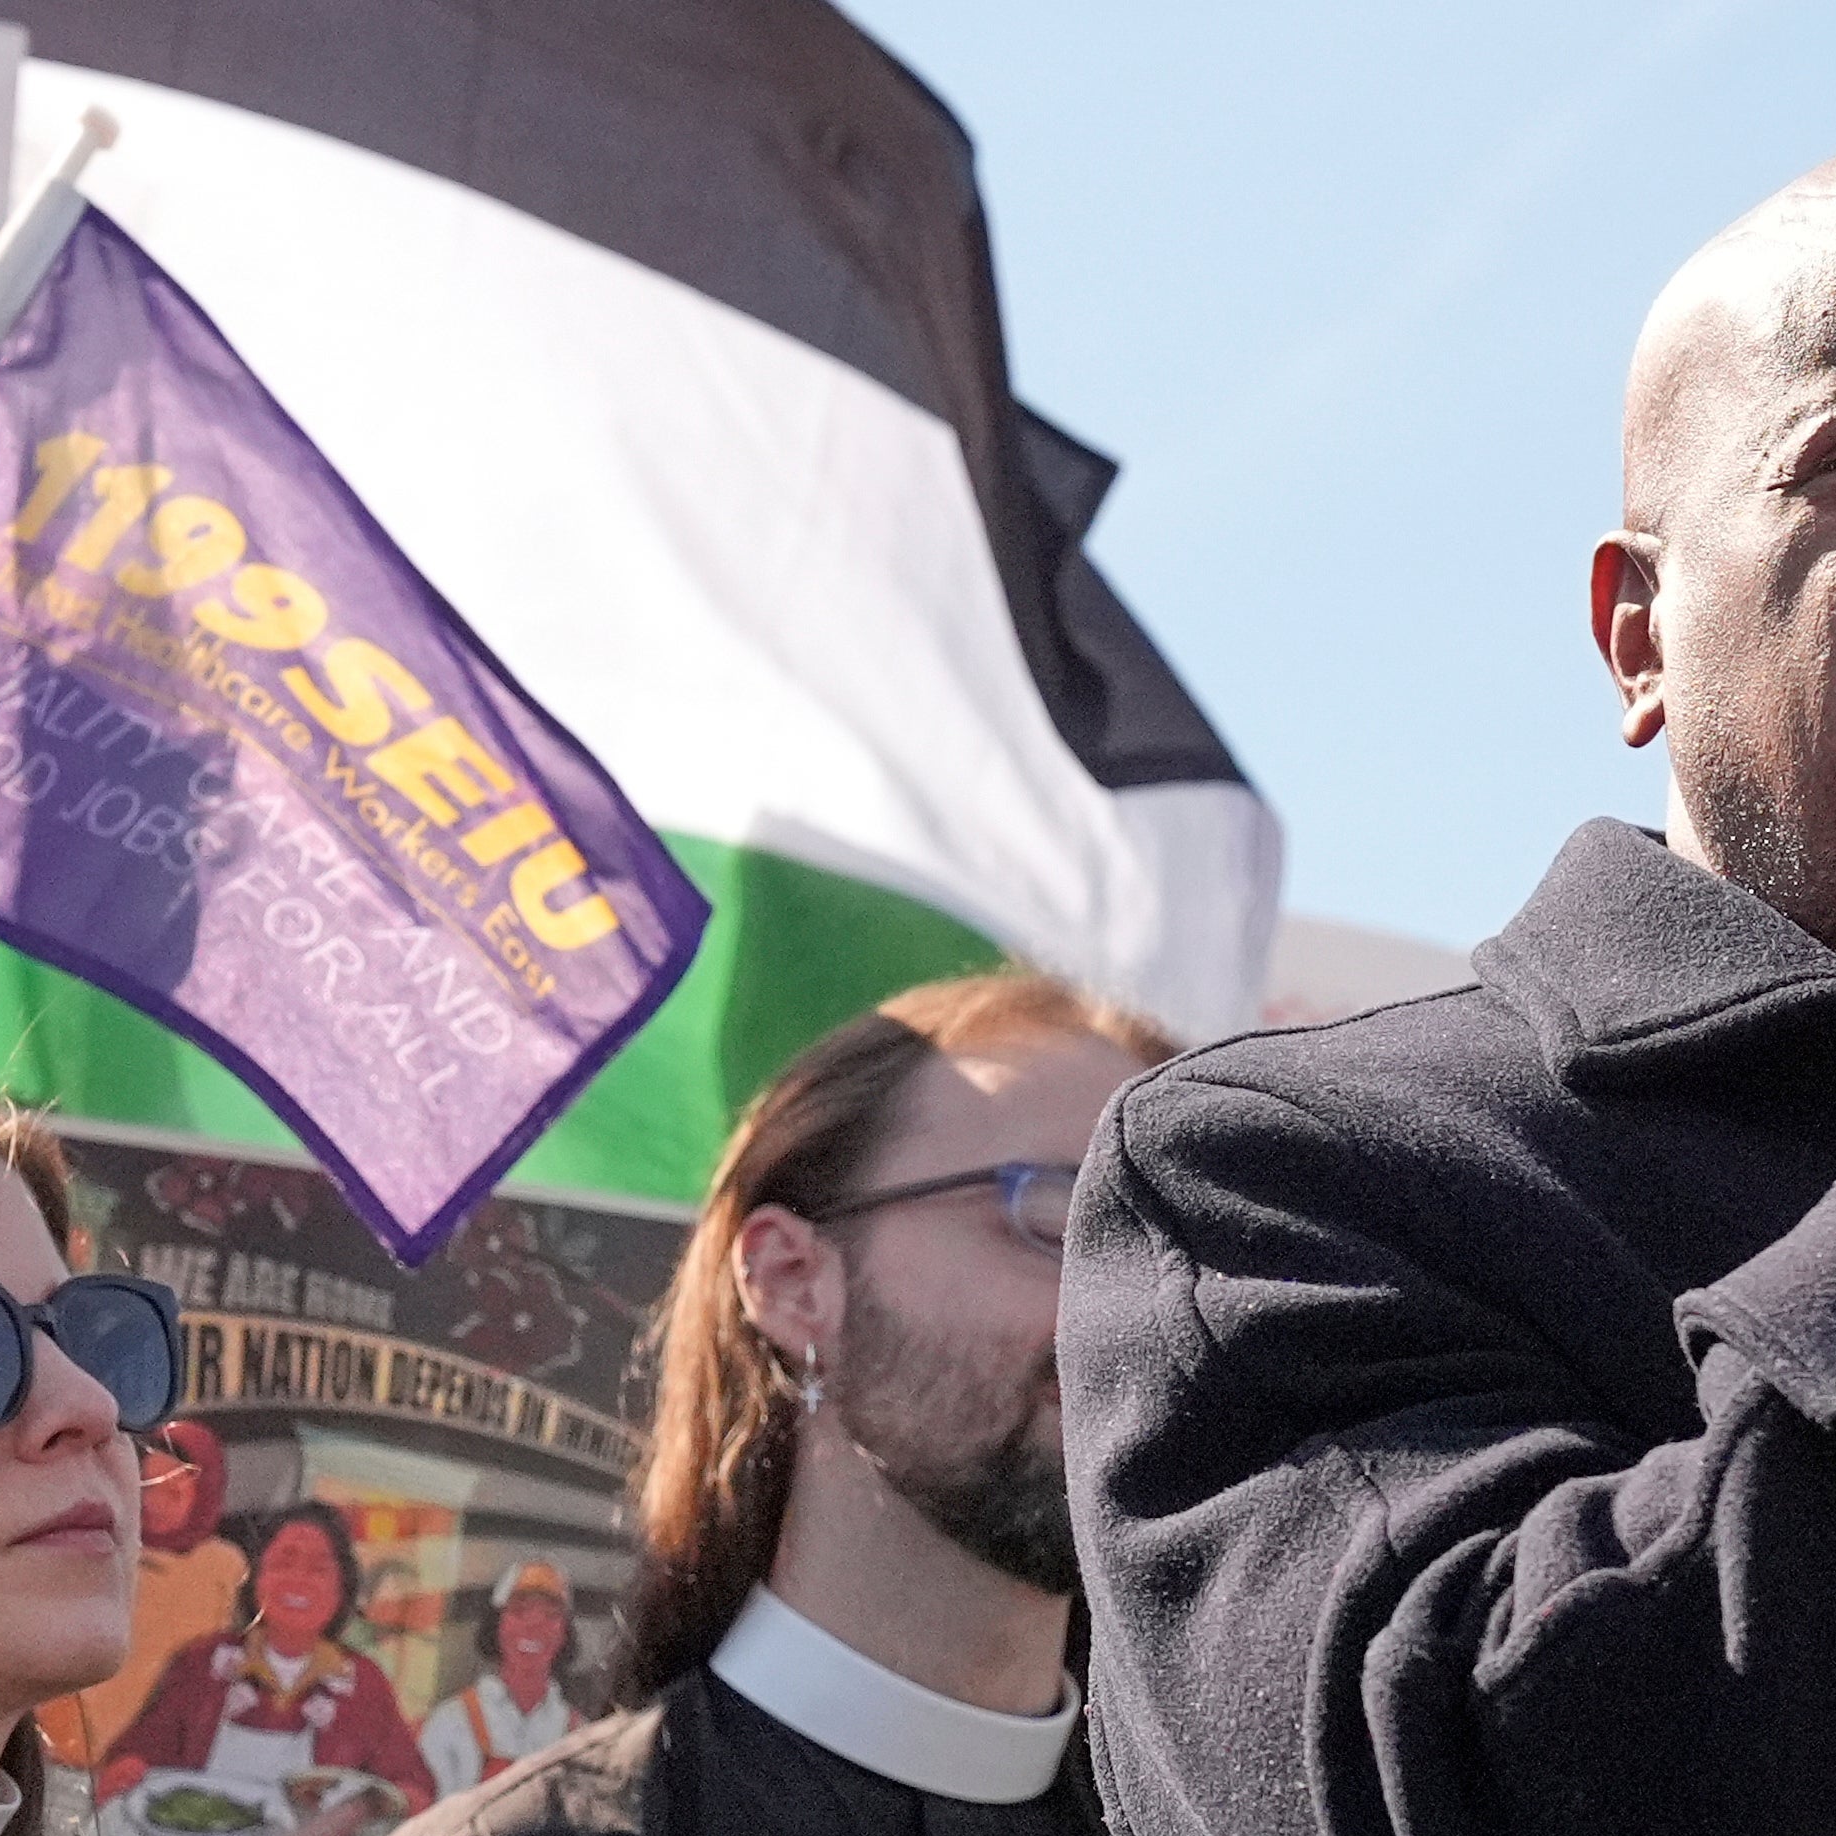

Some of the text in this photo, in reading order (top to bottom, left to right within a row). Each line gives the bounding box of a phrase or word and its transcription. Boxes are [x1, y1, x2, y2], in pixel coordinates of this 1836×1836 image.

[9, 428, 619, 954] 1199SEIU
[188, 761, 368, 906] CARE
[369, 926, 513, 1054] AND
[216, 865, 366, 1000] FOR
[361, 1002, 458, 1104] ALL
[324, 743, 481, 910] Workers
[481, 898, 558, 1000] East
[243, 1327, 375, 1402] NATION
